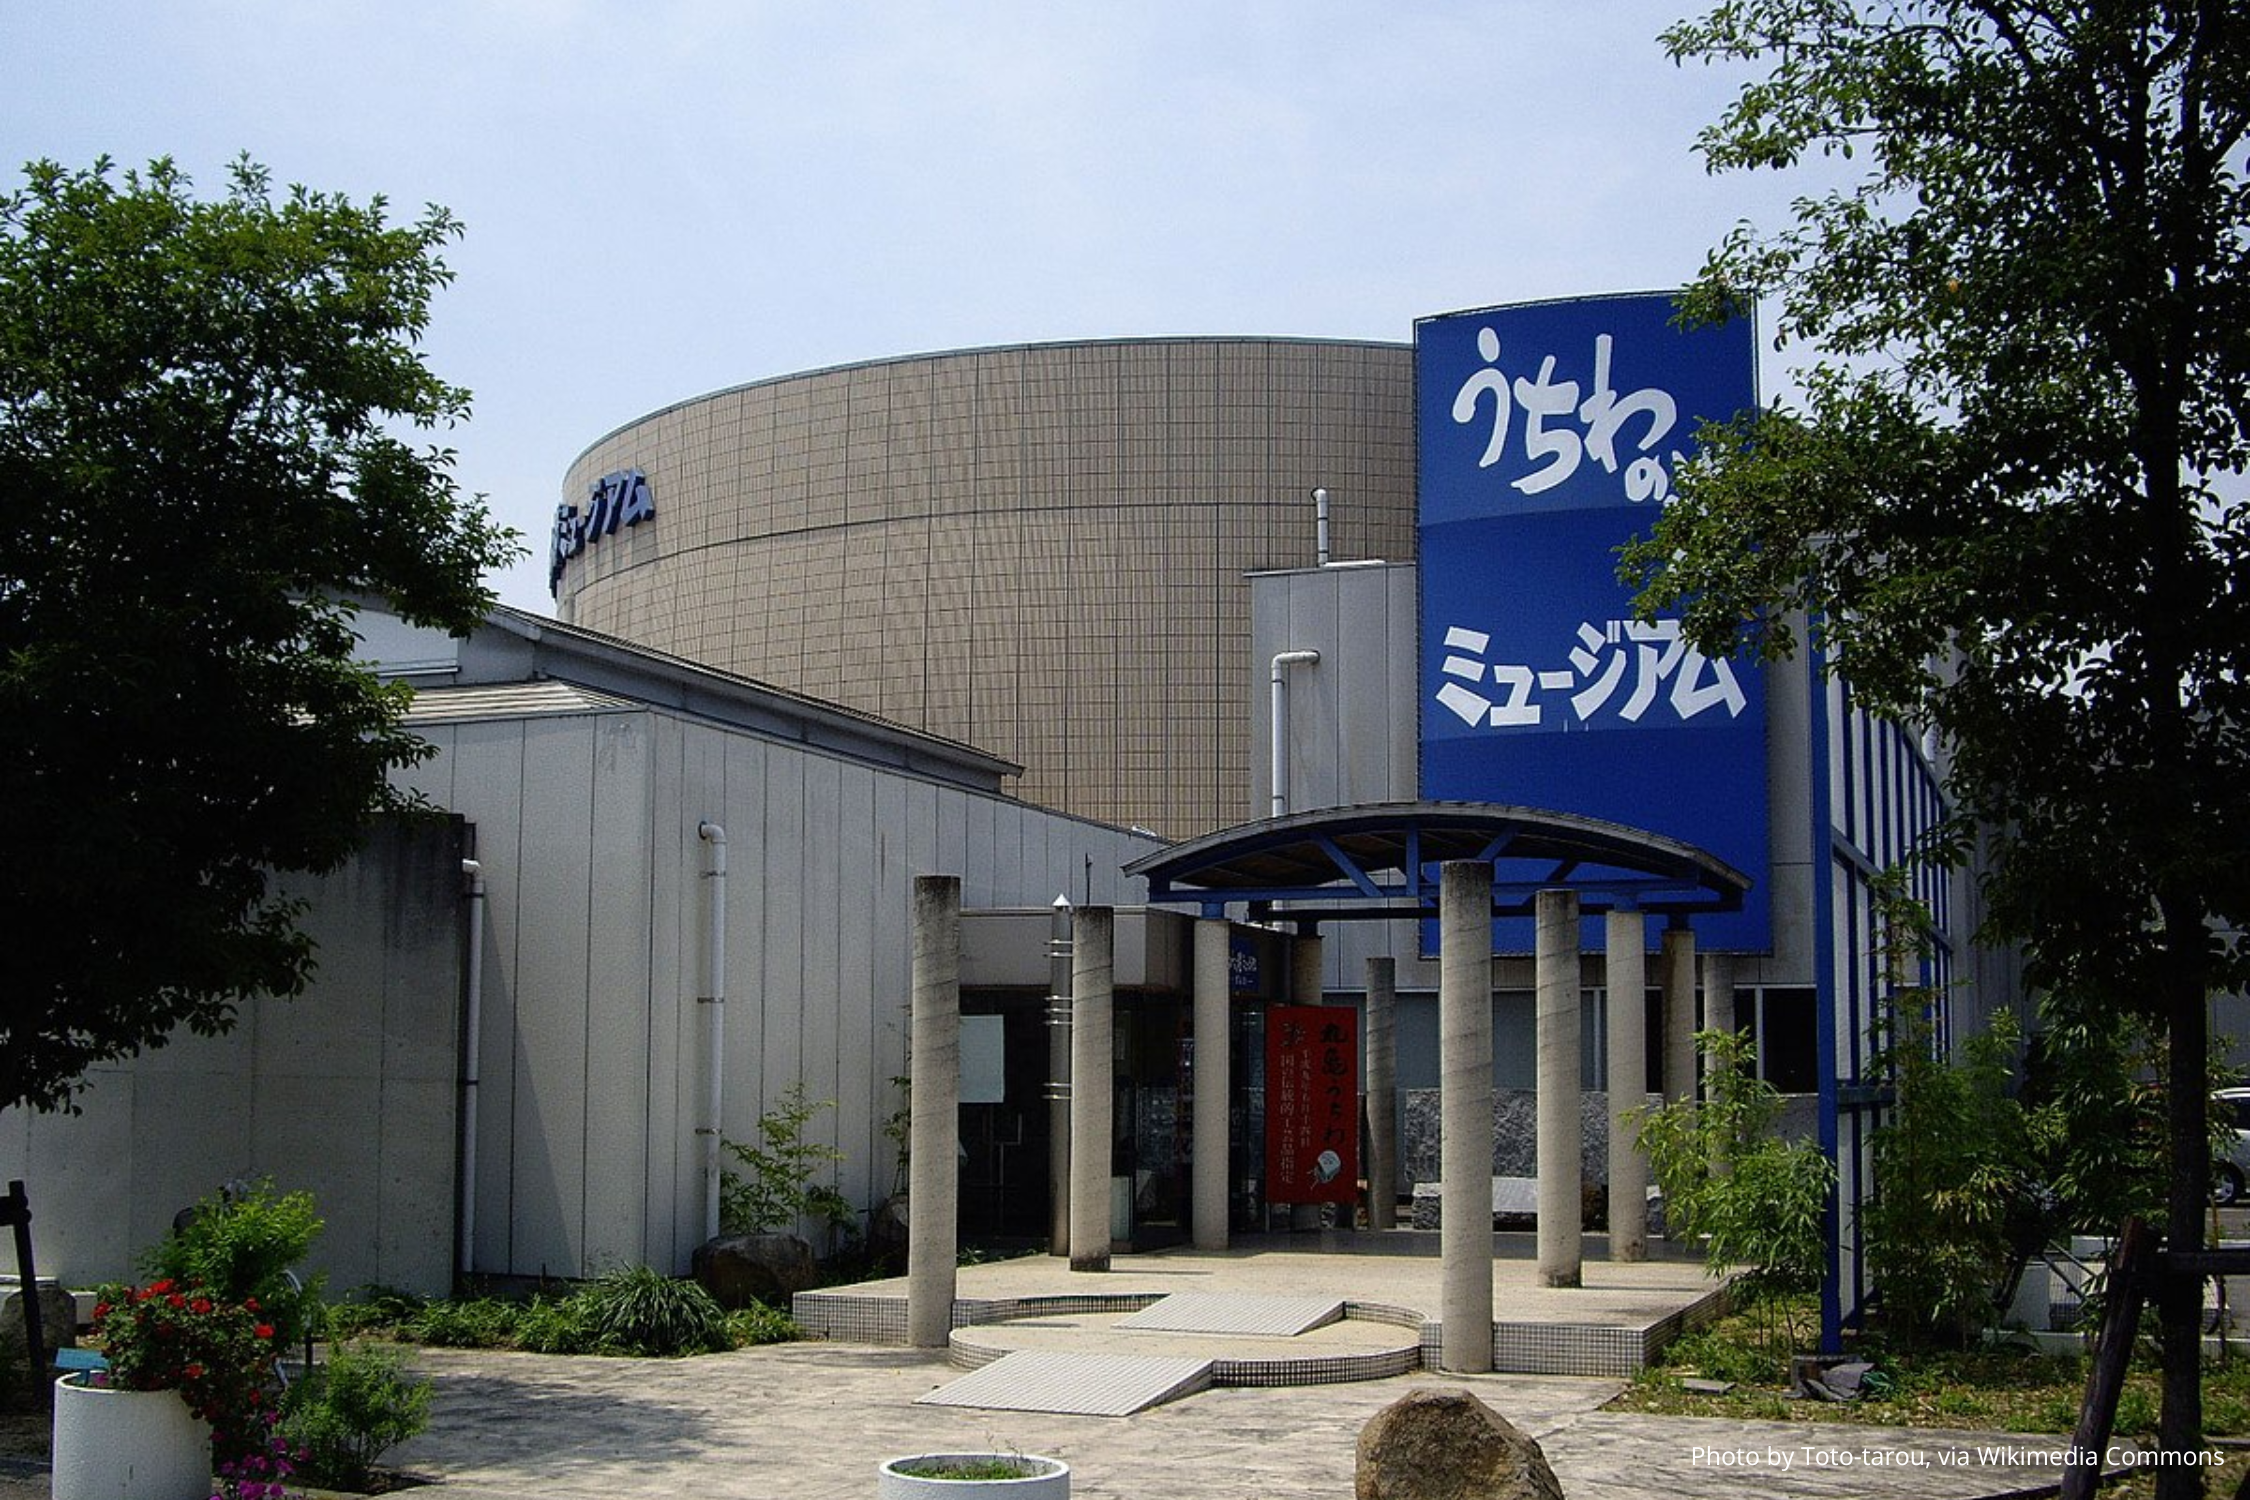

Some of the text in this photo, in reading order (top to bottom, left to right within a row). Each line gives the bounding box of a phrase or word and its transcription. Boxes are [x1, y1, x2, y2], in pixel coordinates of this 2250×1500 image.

[1435, 619, 1747, 728] ミュージアム
